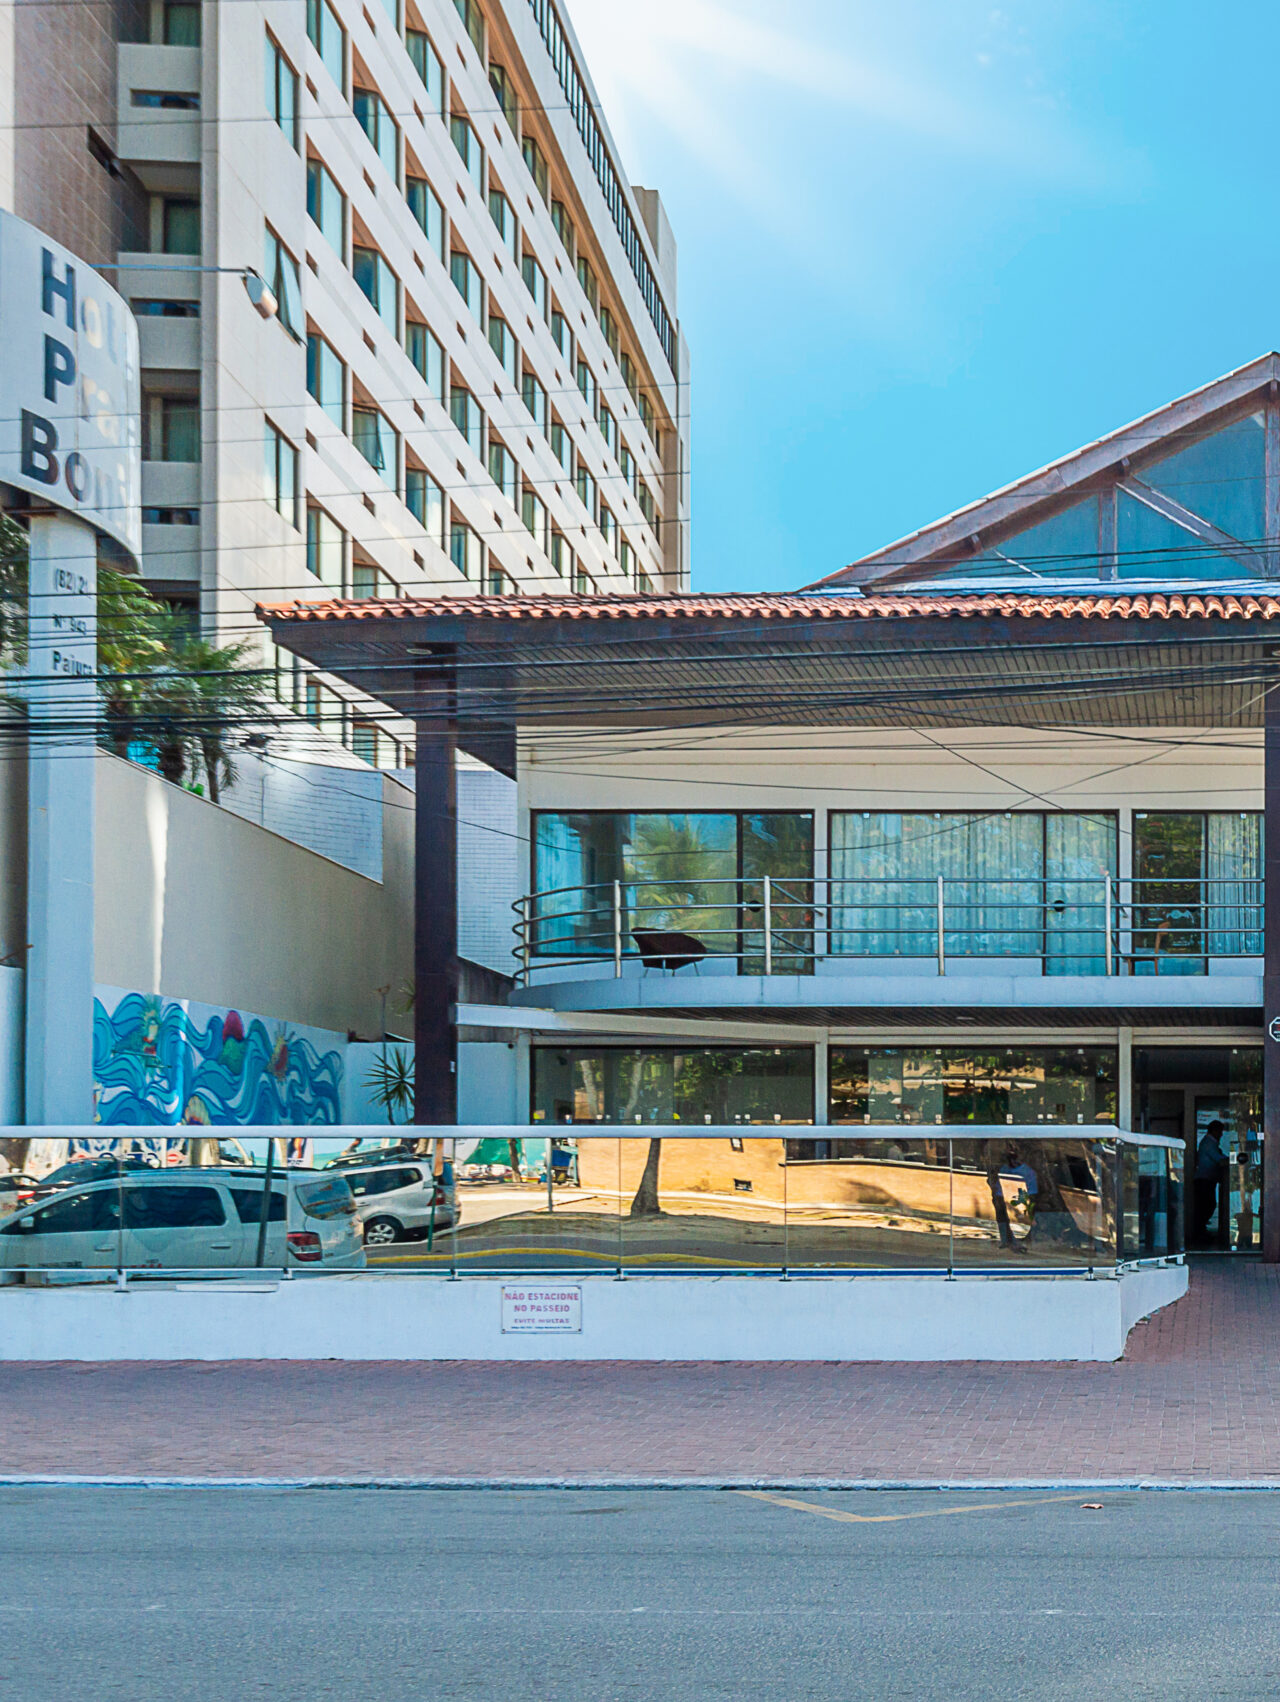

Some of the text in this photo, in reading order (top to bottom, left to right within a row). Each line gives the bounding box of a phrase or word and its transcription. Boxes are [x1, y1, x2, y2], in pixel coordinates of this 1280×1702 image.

[504, 1290, 579, 1301] NÃO ESTACIONE
[514, 1304, 570, 1312] NO PASSEIO
